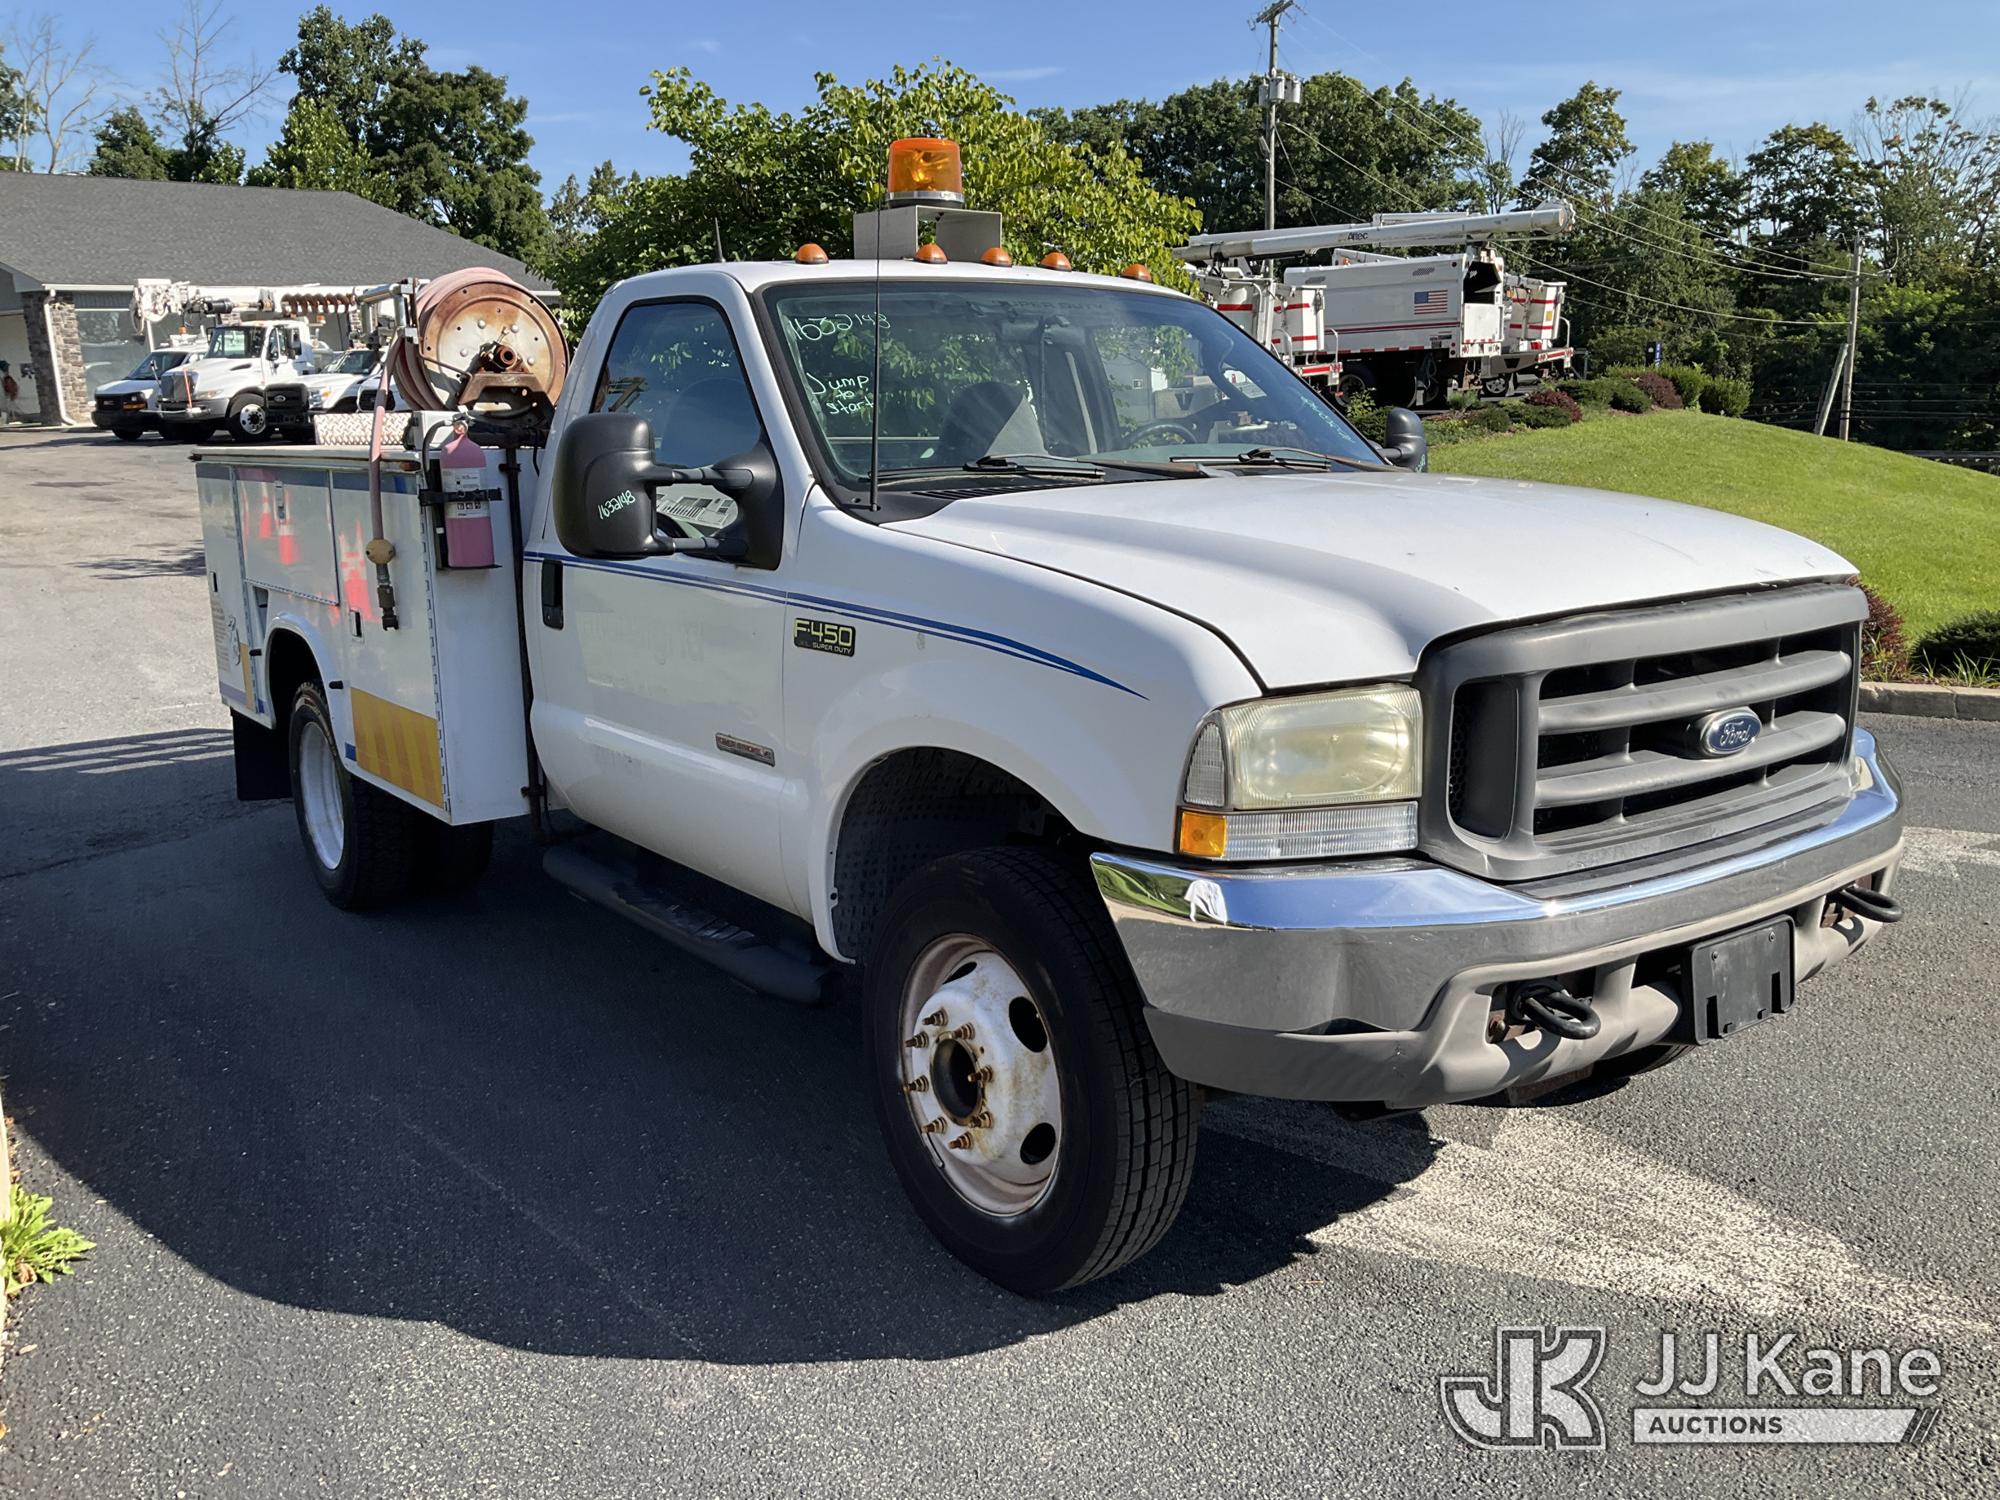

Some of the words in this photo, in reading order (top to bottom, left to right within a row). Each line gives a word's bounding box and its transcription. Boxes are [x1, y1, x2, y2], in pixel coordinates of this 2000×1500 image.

[806, 372, 869, 395] Jump
[835, 389, 855, 400] to
[597, 489, 636, 520] 1632148
[812, 642, 833, 651] SUPER
[834, 645, 852, 654] DUTY
[1720, 721, 1752, 746] Ford
